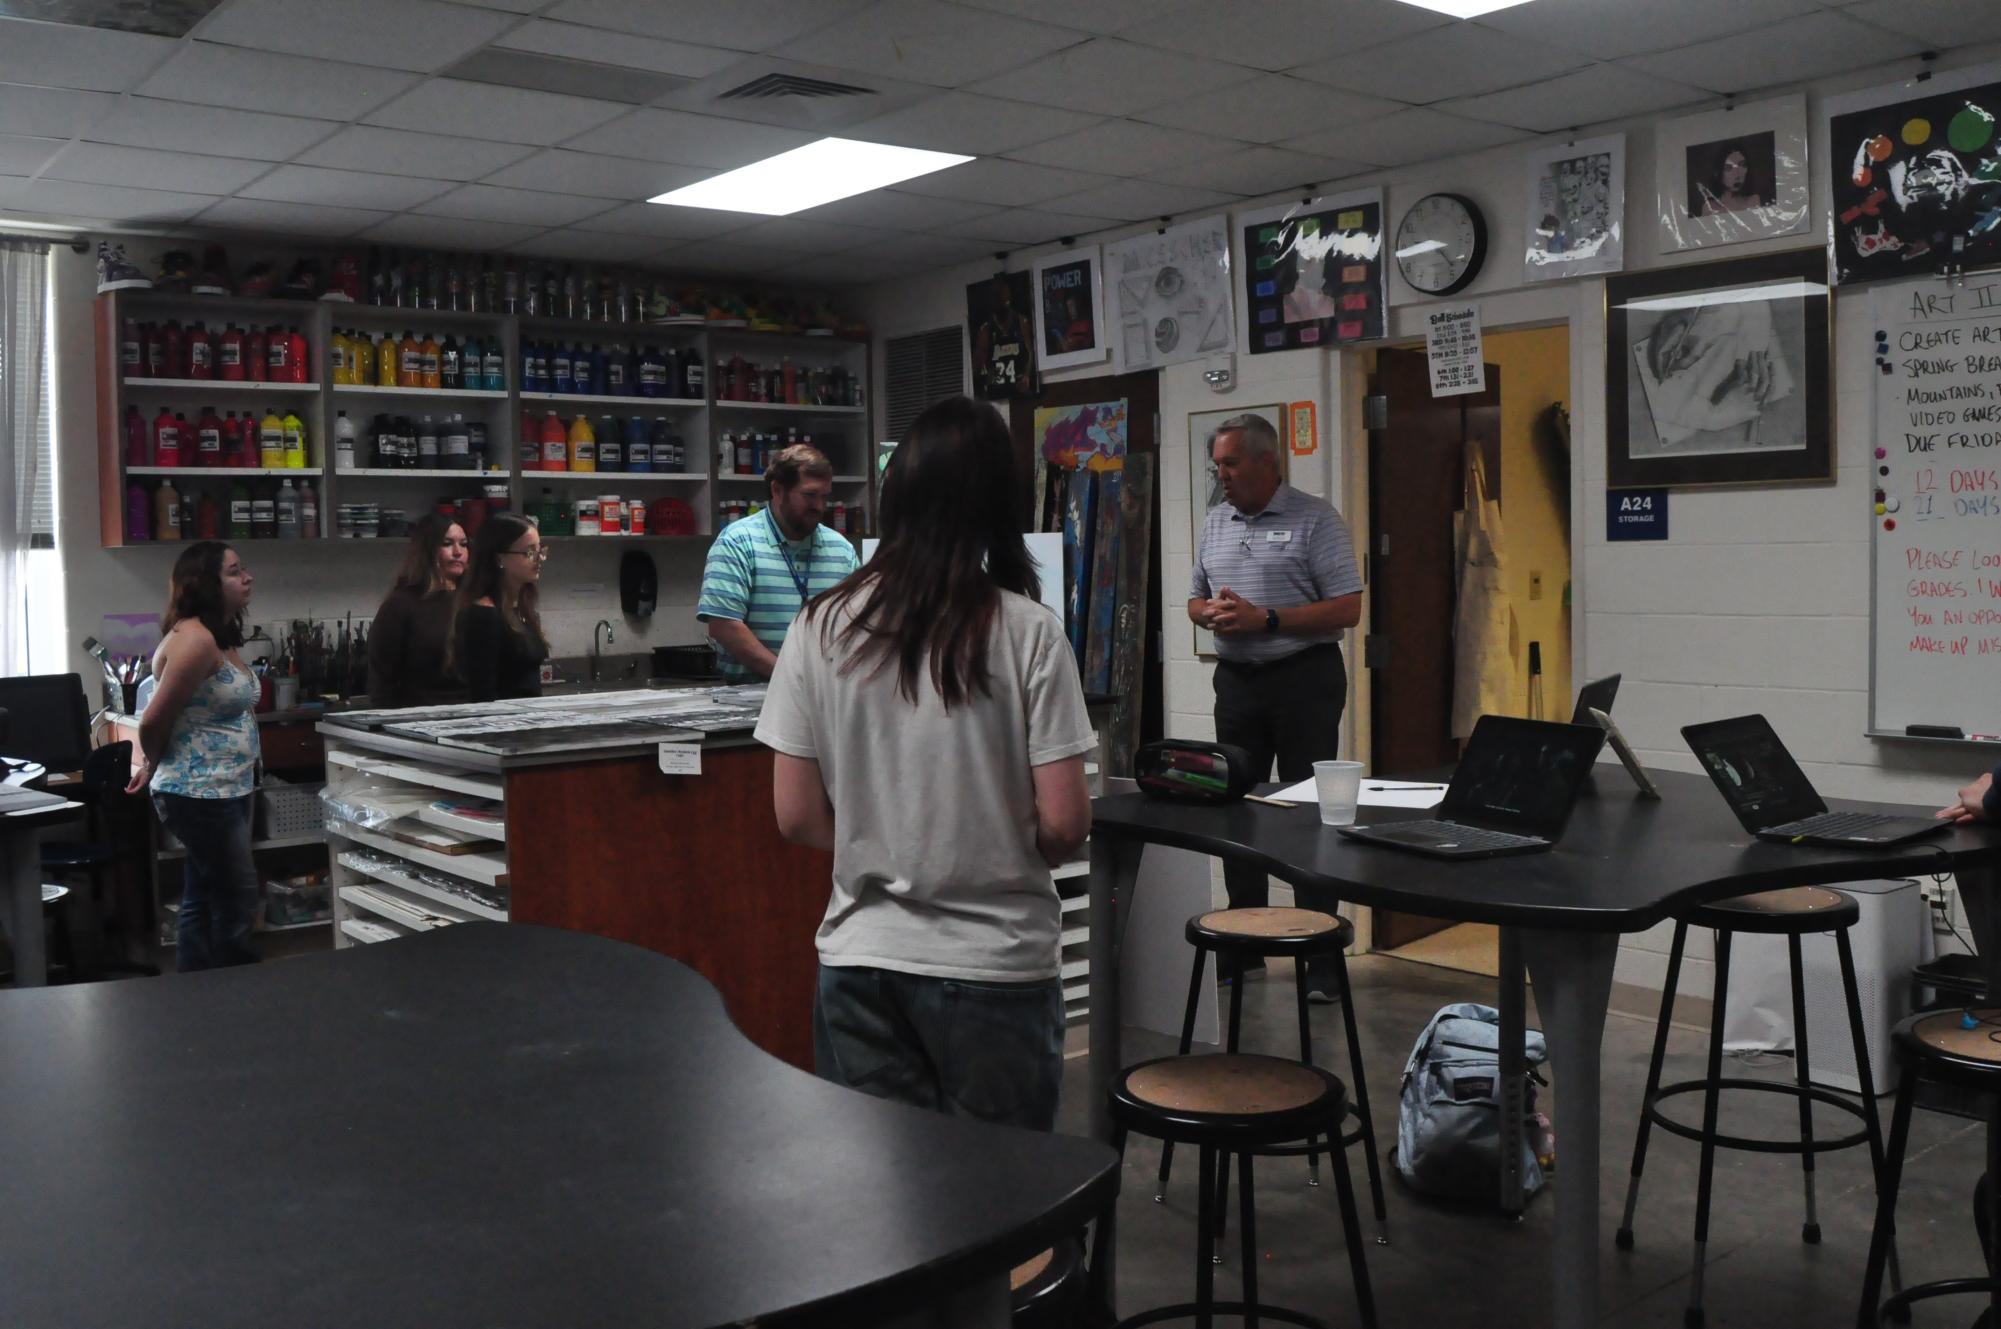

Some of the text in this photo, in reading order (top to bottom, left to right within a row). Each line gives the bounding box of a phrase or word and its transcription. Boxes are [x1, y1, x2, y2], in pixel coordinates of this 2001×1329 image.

[1043, 268, 1083, 291] POWER
[1909, 284, 2001, 319] ART II
[1900, 328, 1961, 352] CREATE
[992, 360, 1016, 384] 24
[1902, 358, 1959, 378] SPRING
[1909, 404, 2001, 427] VIDEO GAMES
[1904, 432, 1941, 453] DUE
[1915, 468, 1999, 494] 12 DAYS
[1620, 496, 1652, 511] A24
[1954, 494, 2000, 517] DAYS
[1618, 514, 1655, 523] STORAGE
[1906, 548, 1963, 570] PLEASE
[1943, 609, 1964, 626] AN
[1909, 635, 1946, 654] MAKE
[1950, 635, 1969, 656] UP
